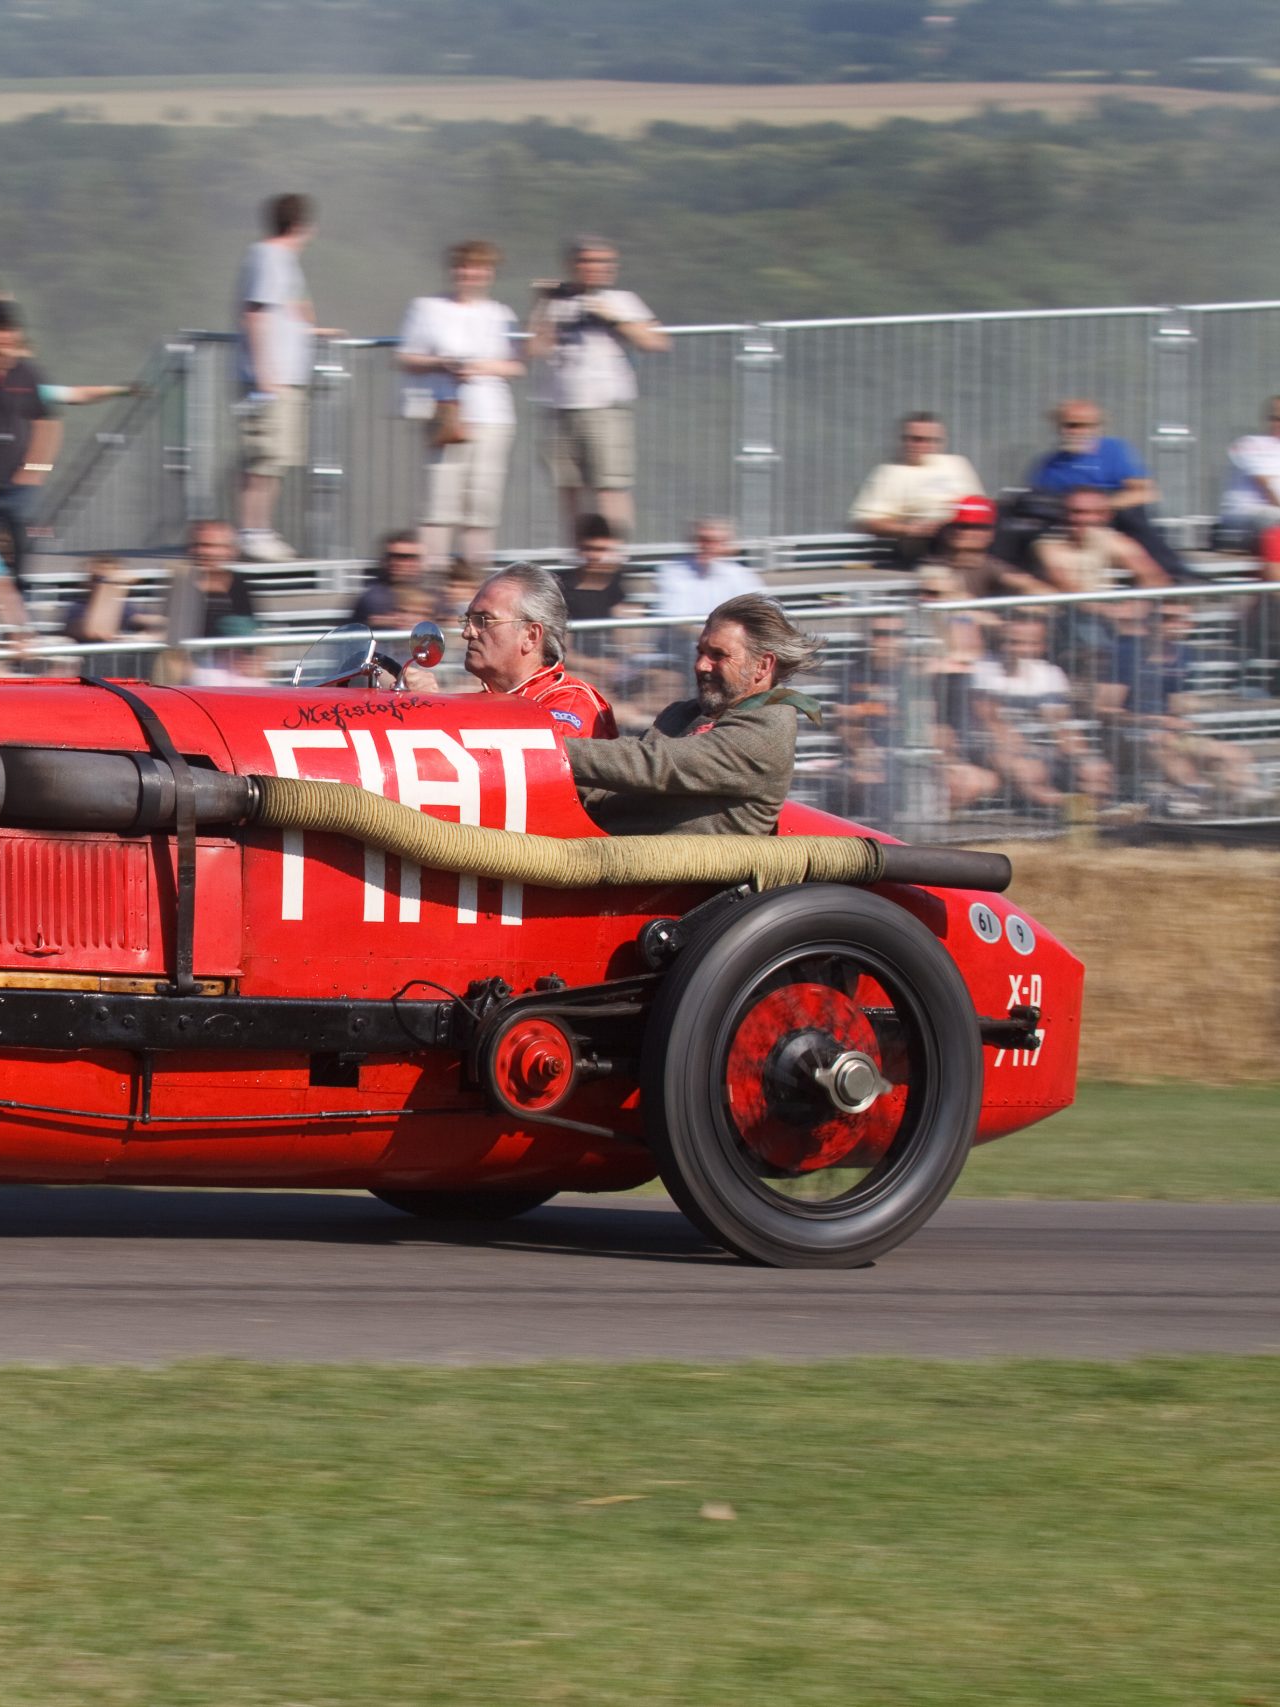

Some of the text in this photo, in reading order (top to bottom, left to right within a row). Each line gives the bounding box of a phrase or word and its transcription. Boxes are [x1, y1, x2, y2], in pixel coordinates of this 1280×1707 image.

[263, 729, 557, 925] FIAT
[979, 912, 993, 933] 61
[1016, 924, 1024, 943] 9
